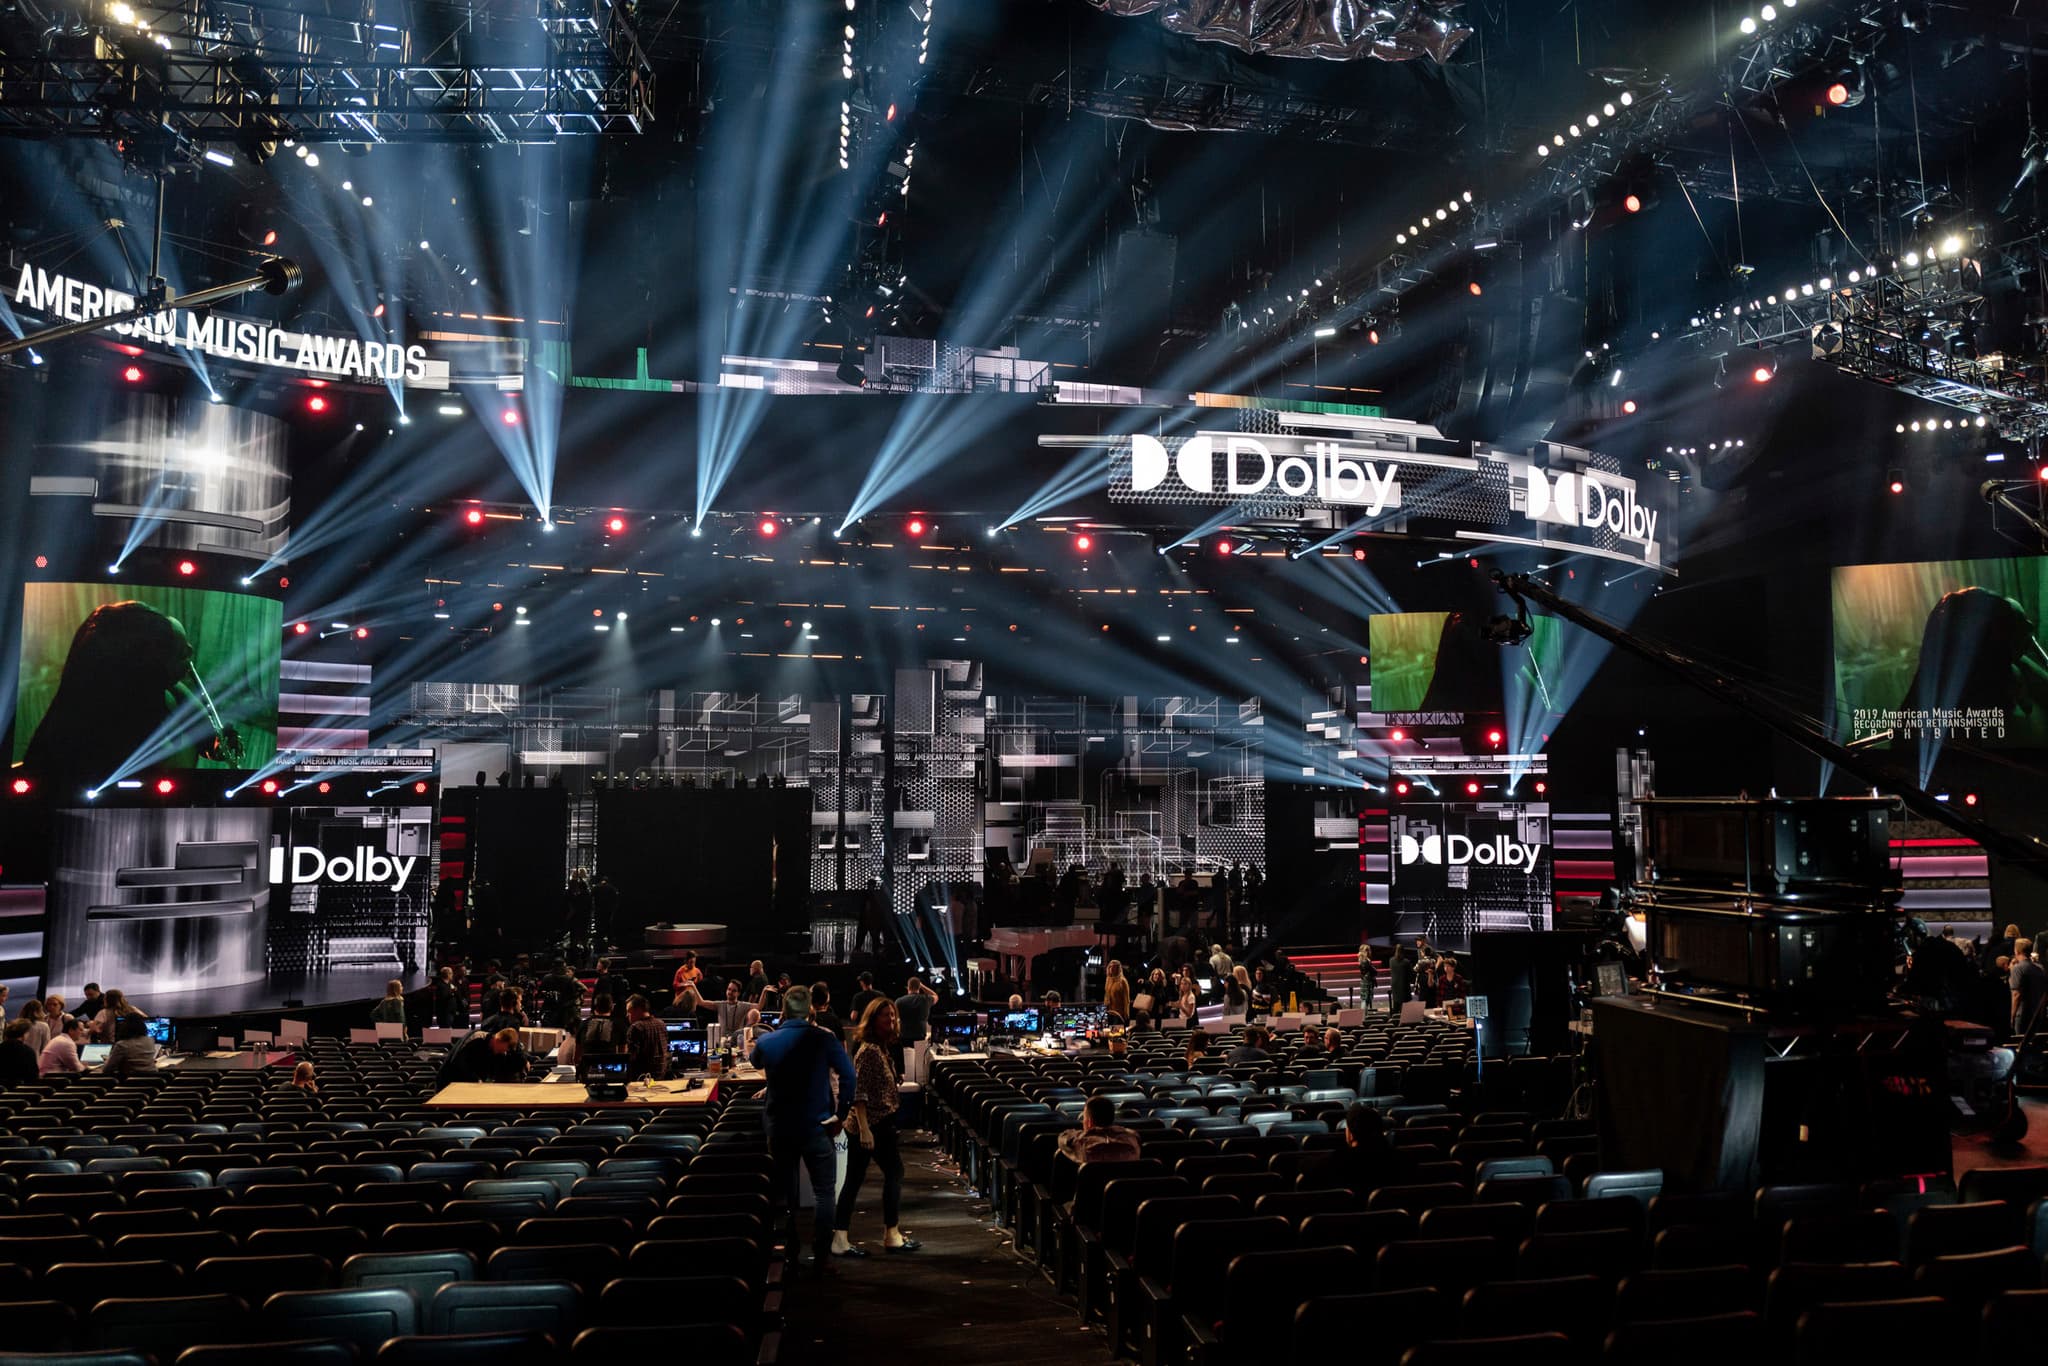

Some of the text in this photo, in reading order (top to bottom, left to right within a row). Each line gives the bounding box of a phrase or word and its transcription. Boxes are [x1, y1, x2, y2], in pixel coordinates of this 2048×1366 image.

[15, 263, 426, 381] AMERICAN MUSIC AWARDS
[1227, 436, 1398, 517] Dolby
[1582, 475, 1657, 555] Dolby
[1854, 706, 2004, 720] 2019 American Music Awards
[1854, 717, 2005, 729] RECORDING AND RETRANSMISSION
[301, 756, 336, 765] AMERICAN
[338, 756, 359, 765] MUSIC
[360, 757, 388, 766] AWARDS
[392, 757, 421, 766] AMERICAN
[914, 752, 943, 761] AMERICAN
[944, 752, 962, 761] MUSIC
[292, 846, 416, 892] Dolby
[1448, 835, 1541, 874] Dolby
